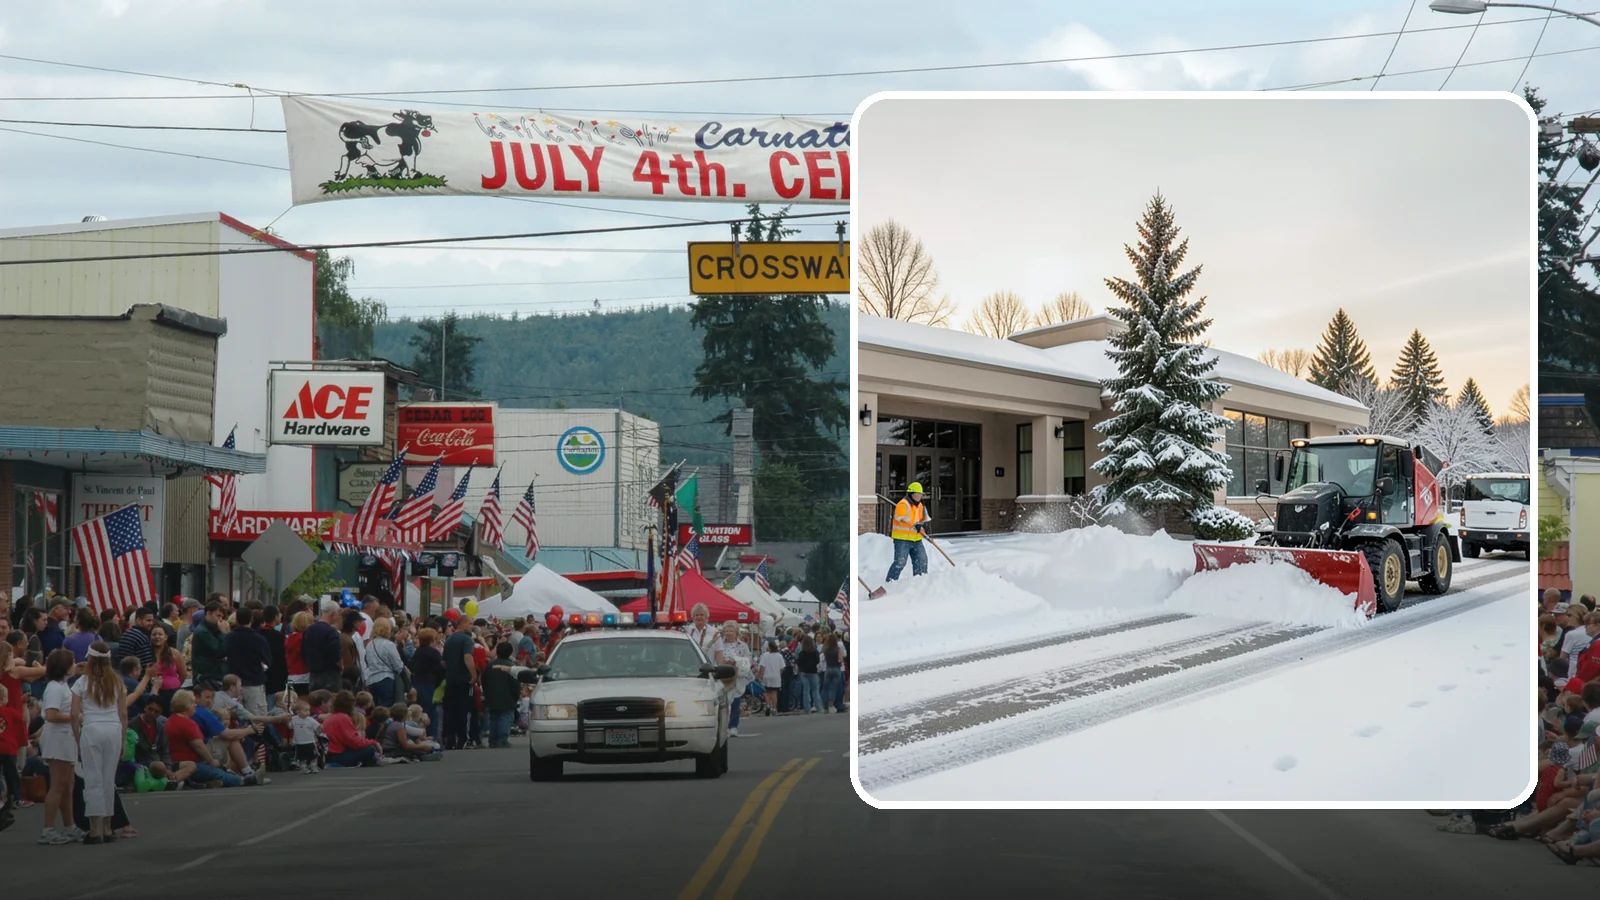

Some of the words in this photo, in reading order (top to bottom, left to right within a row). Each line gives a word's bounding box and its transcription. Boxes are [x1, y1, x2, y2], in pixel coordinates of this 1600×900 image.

[695, 122, 850, 149] Carnat
[481, 141, 604, 192] JULY
[632, 150, 746, 197] 4th.
[697, 255, 850, 280] CROSSWA
[283, 380, 373, 419] ACE
[406, 409, 452, 421] CEDAR
[283, 421, 371, 436] Hardware
[416, 428, 477, 446] Coca-Cola
[353, 467, 384, 480] Simpl
[95, 485, 124, 495] Vincent
[126, 485, 136, 494] de
[138, 486, 155, 495] Paul
[213, 516, 330, 535] HARDARE
[688, 526, 741, 535] CRNATION
[699, 535, 730, 543] GLASS
